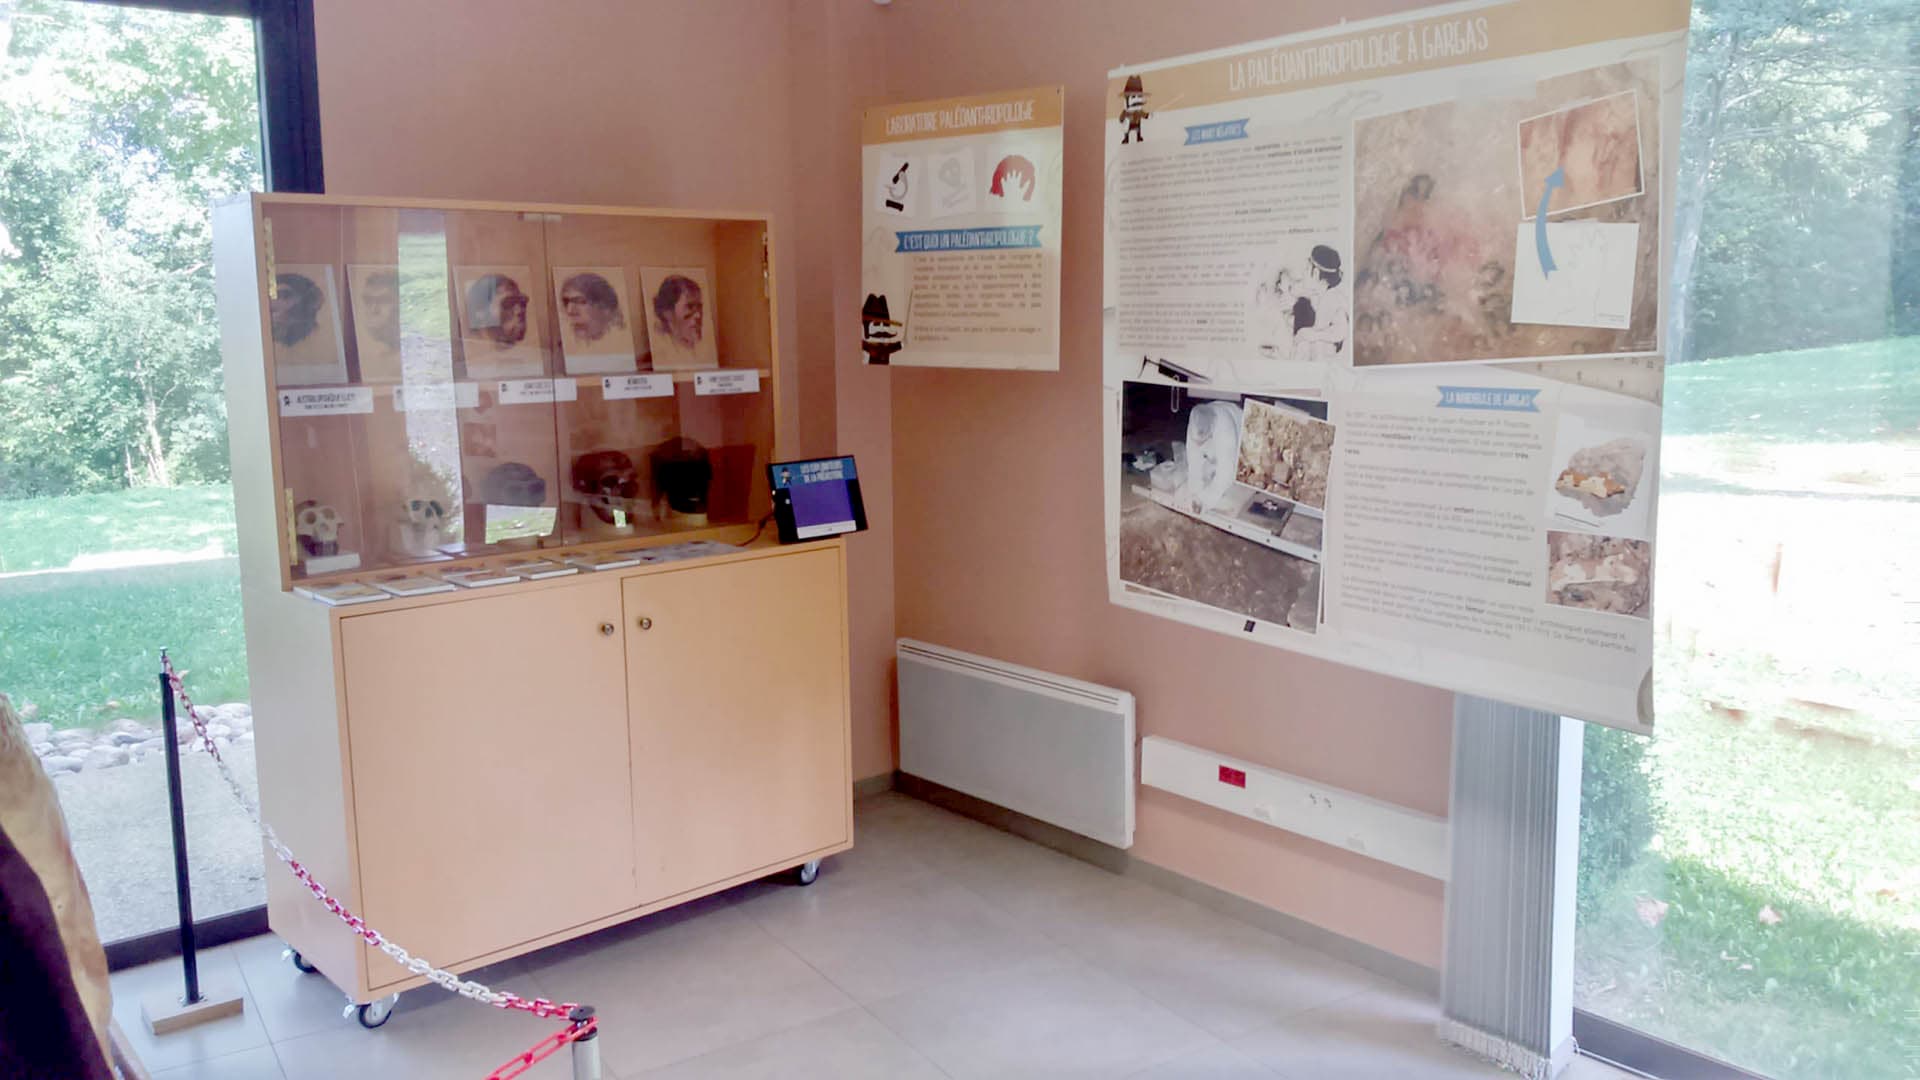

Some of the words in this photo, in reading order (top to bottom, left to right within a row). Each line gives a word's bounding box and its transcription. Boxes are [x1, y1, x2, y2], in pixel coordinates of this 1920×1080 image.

[1229, 63, 1246, 91] LA
[1249, 31, 1403, 89] PALÉOANTHROPOLOGIE
[1407, 25, 1420, 62] À
[1421, 17, 1489, 60] GARGAS
[886, 111, 938, 136] LABORATOIRE
[939, 99, 1035, 130] PALÉOANTHROPOLOGIE
